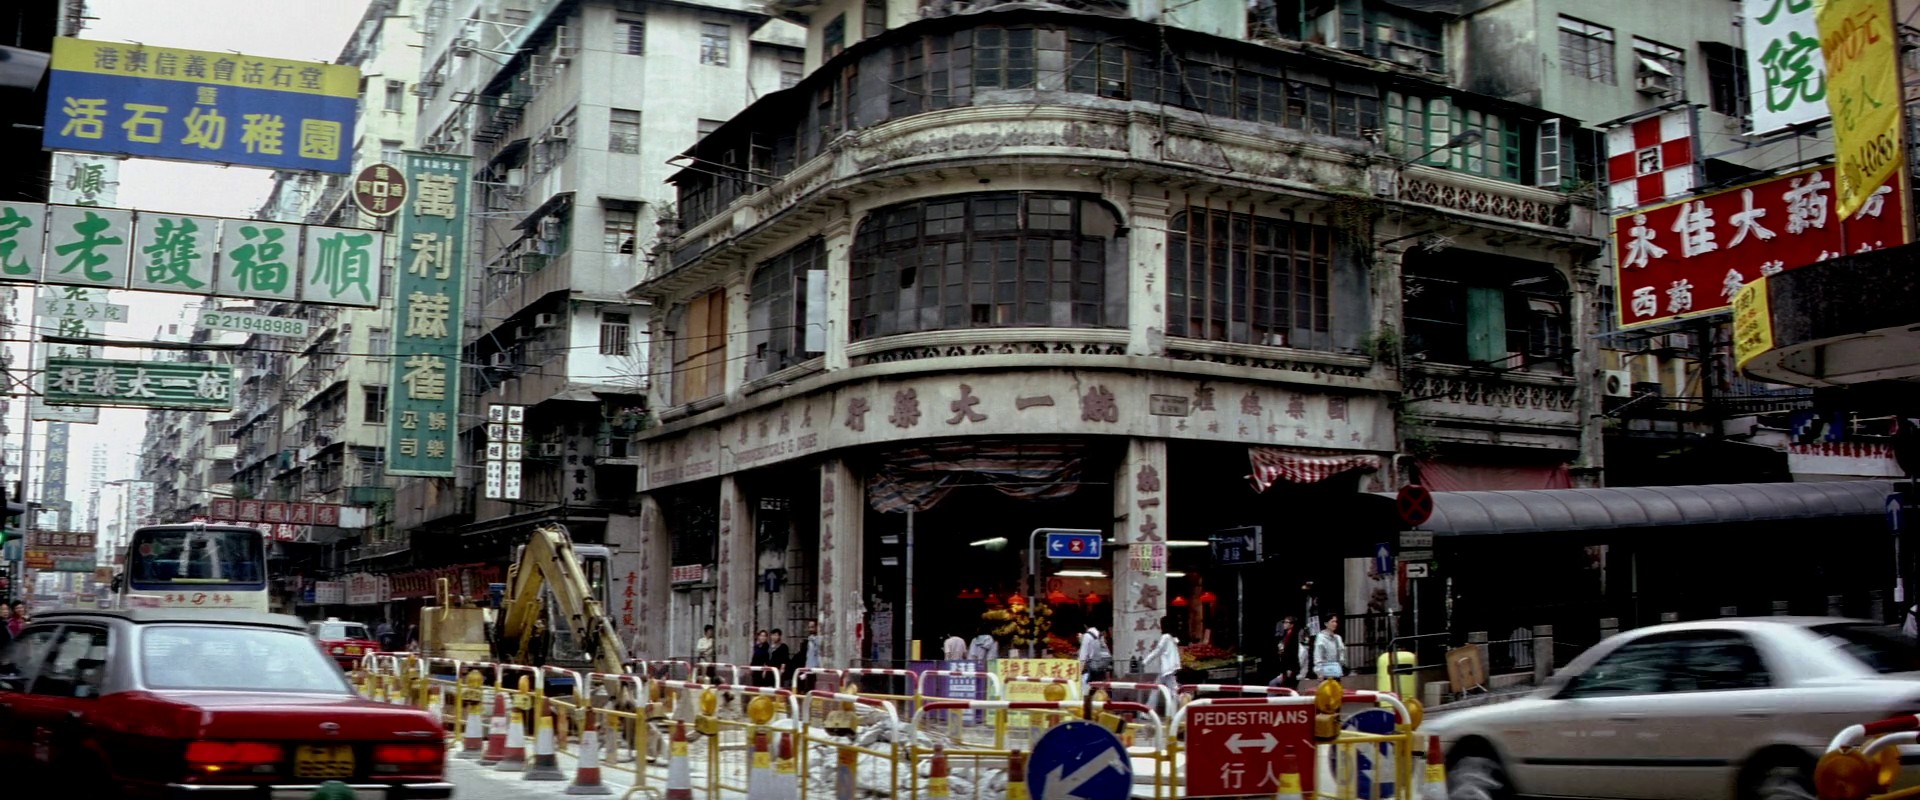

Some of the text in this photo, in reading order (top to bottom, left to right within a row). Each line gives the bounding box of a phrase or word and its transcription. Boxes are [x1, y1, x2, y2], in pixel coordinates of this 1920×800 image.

[94, 47, 323, 91] 港澳信義會活石堂
[61, 97, 341, 160] 活石幼稚園
[222, 316, 303, 334] 21948988
[1137, 465, 1161, 610] 統一大行
[1194, 710, 1308, 727] PEDESTRIANS
[1221, 761, 1280, 789] 行人
